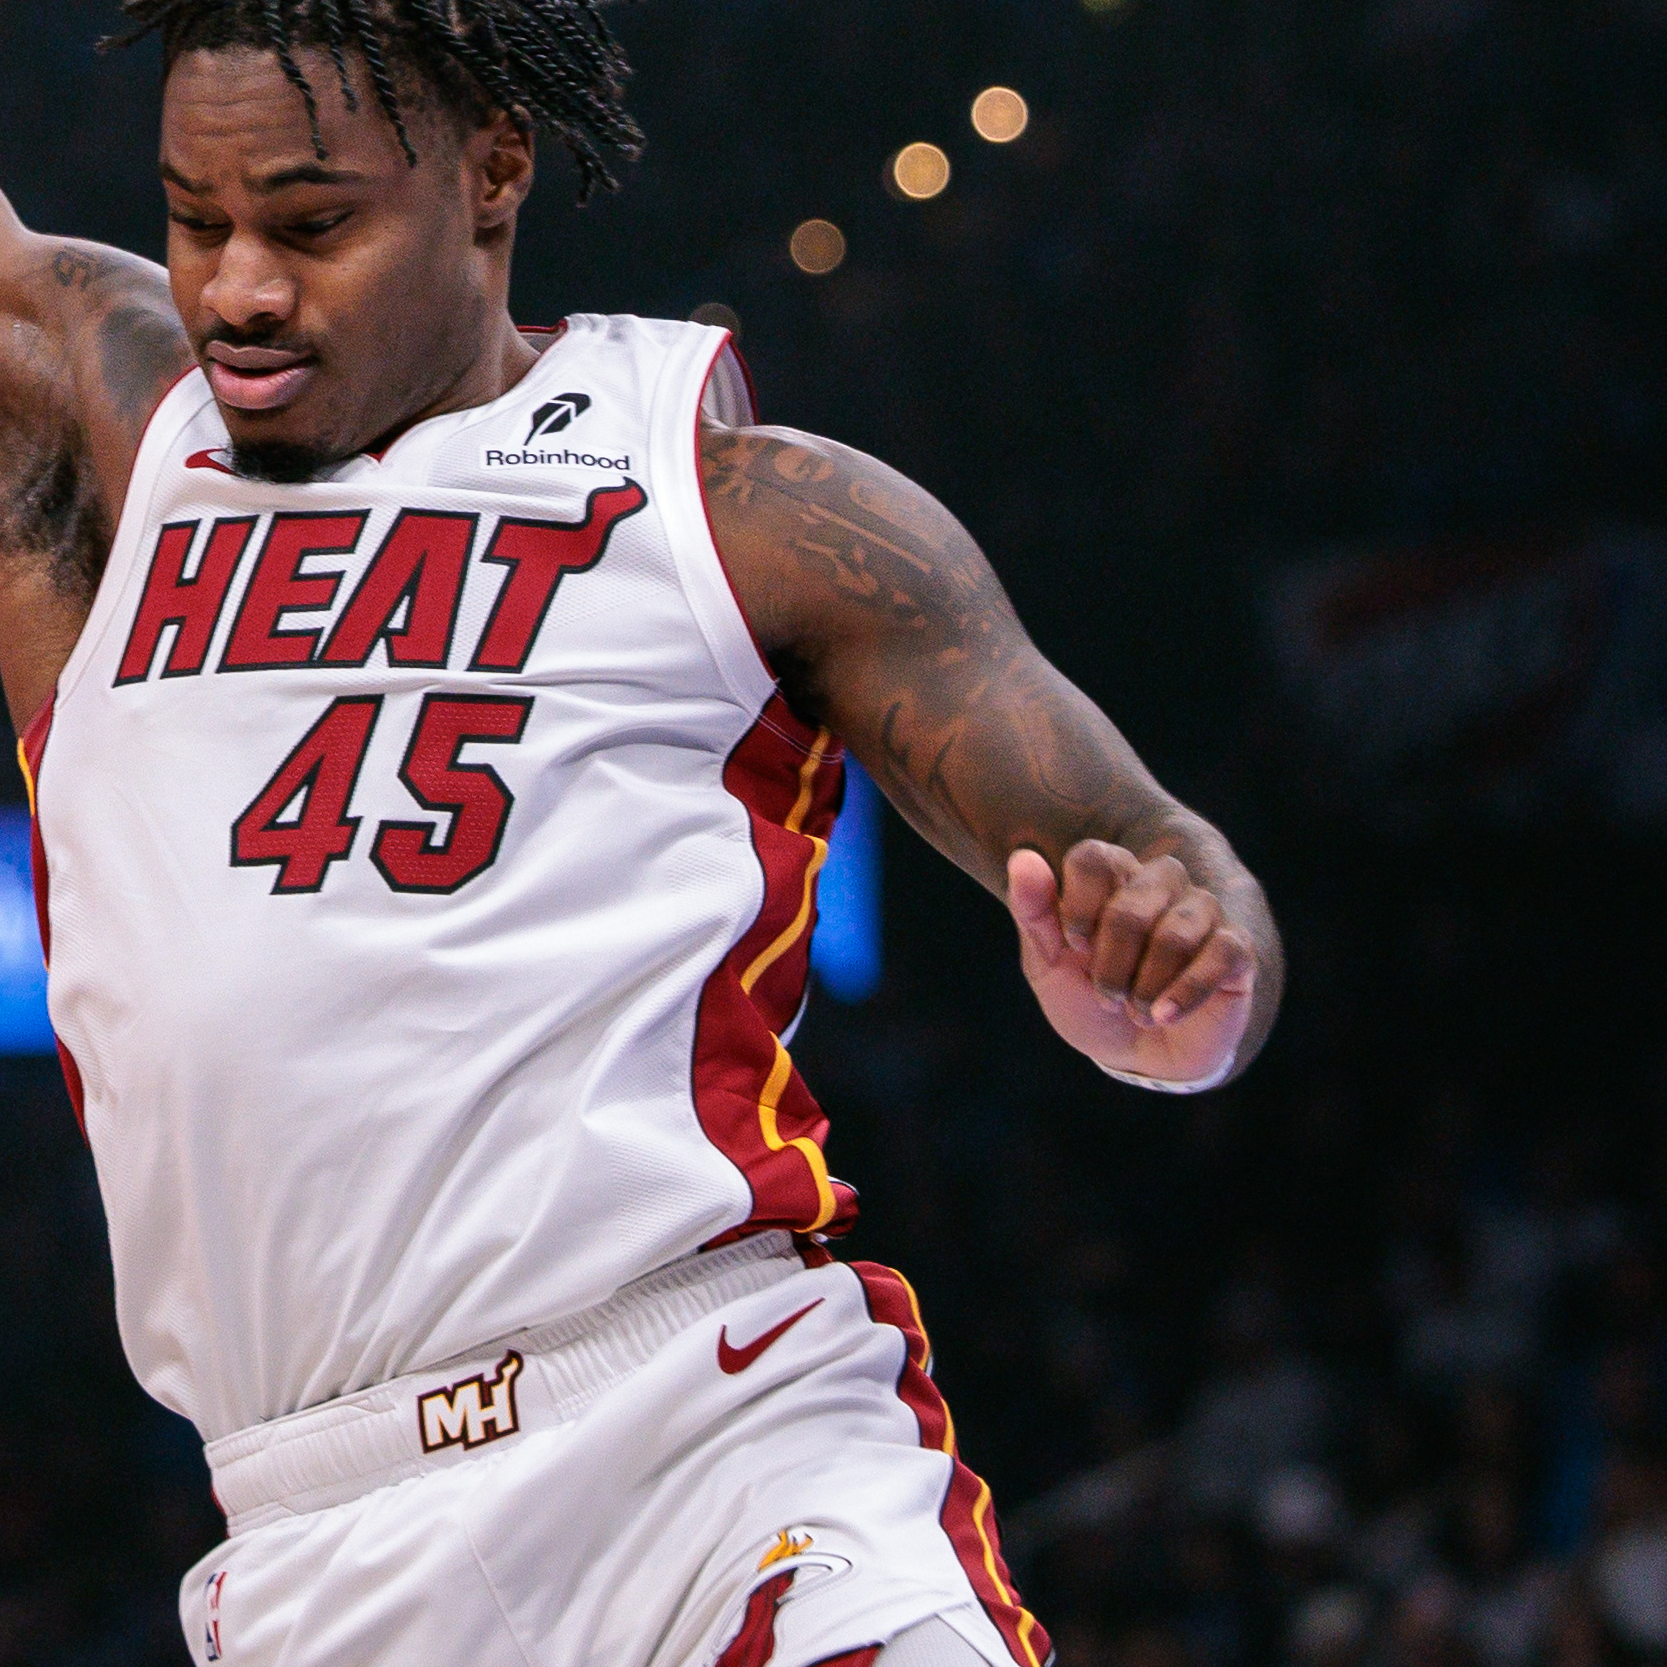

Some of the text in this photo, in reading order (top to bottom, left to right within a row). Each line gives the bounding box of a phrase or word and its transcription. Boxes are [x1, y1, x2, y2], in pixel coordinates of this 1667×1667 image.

[485, 449, 631, 471] Robinhood
[112, 477, 648, 689] HEAT
[229, 692, 535, 896] 45
